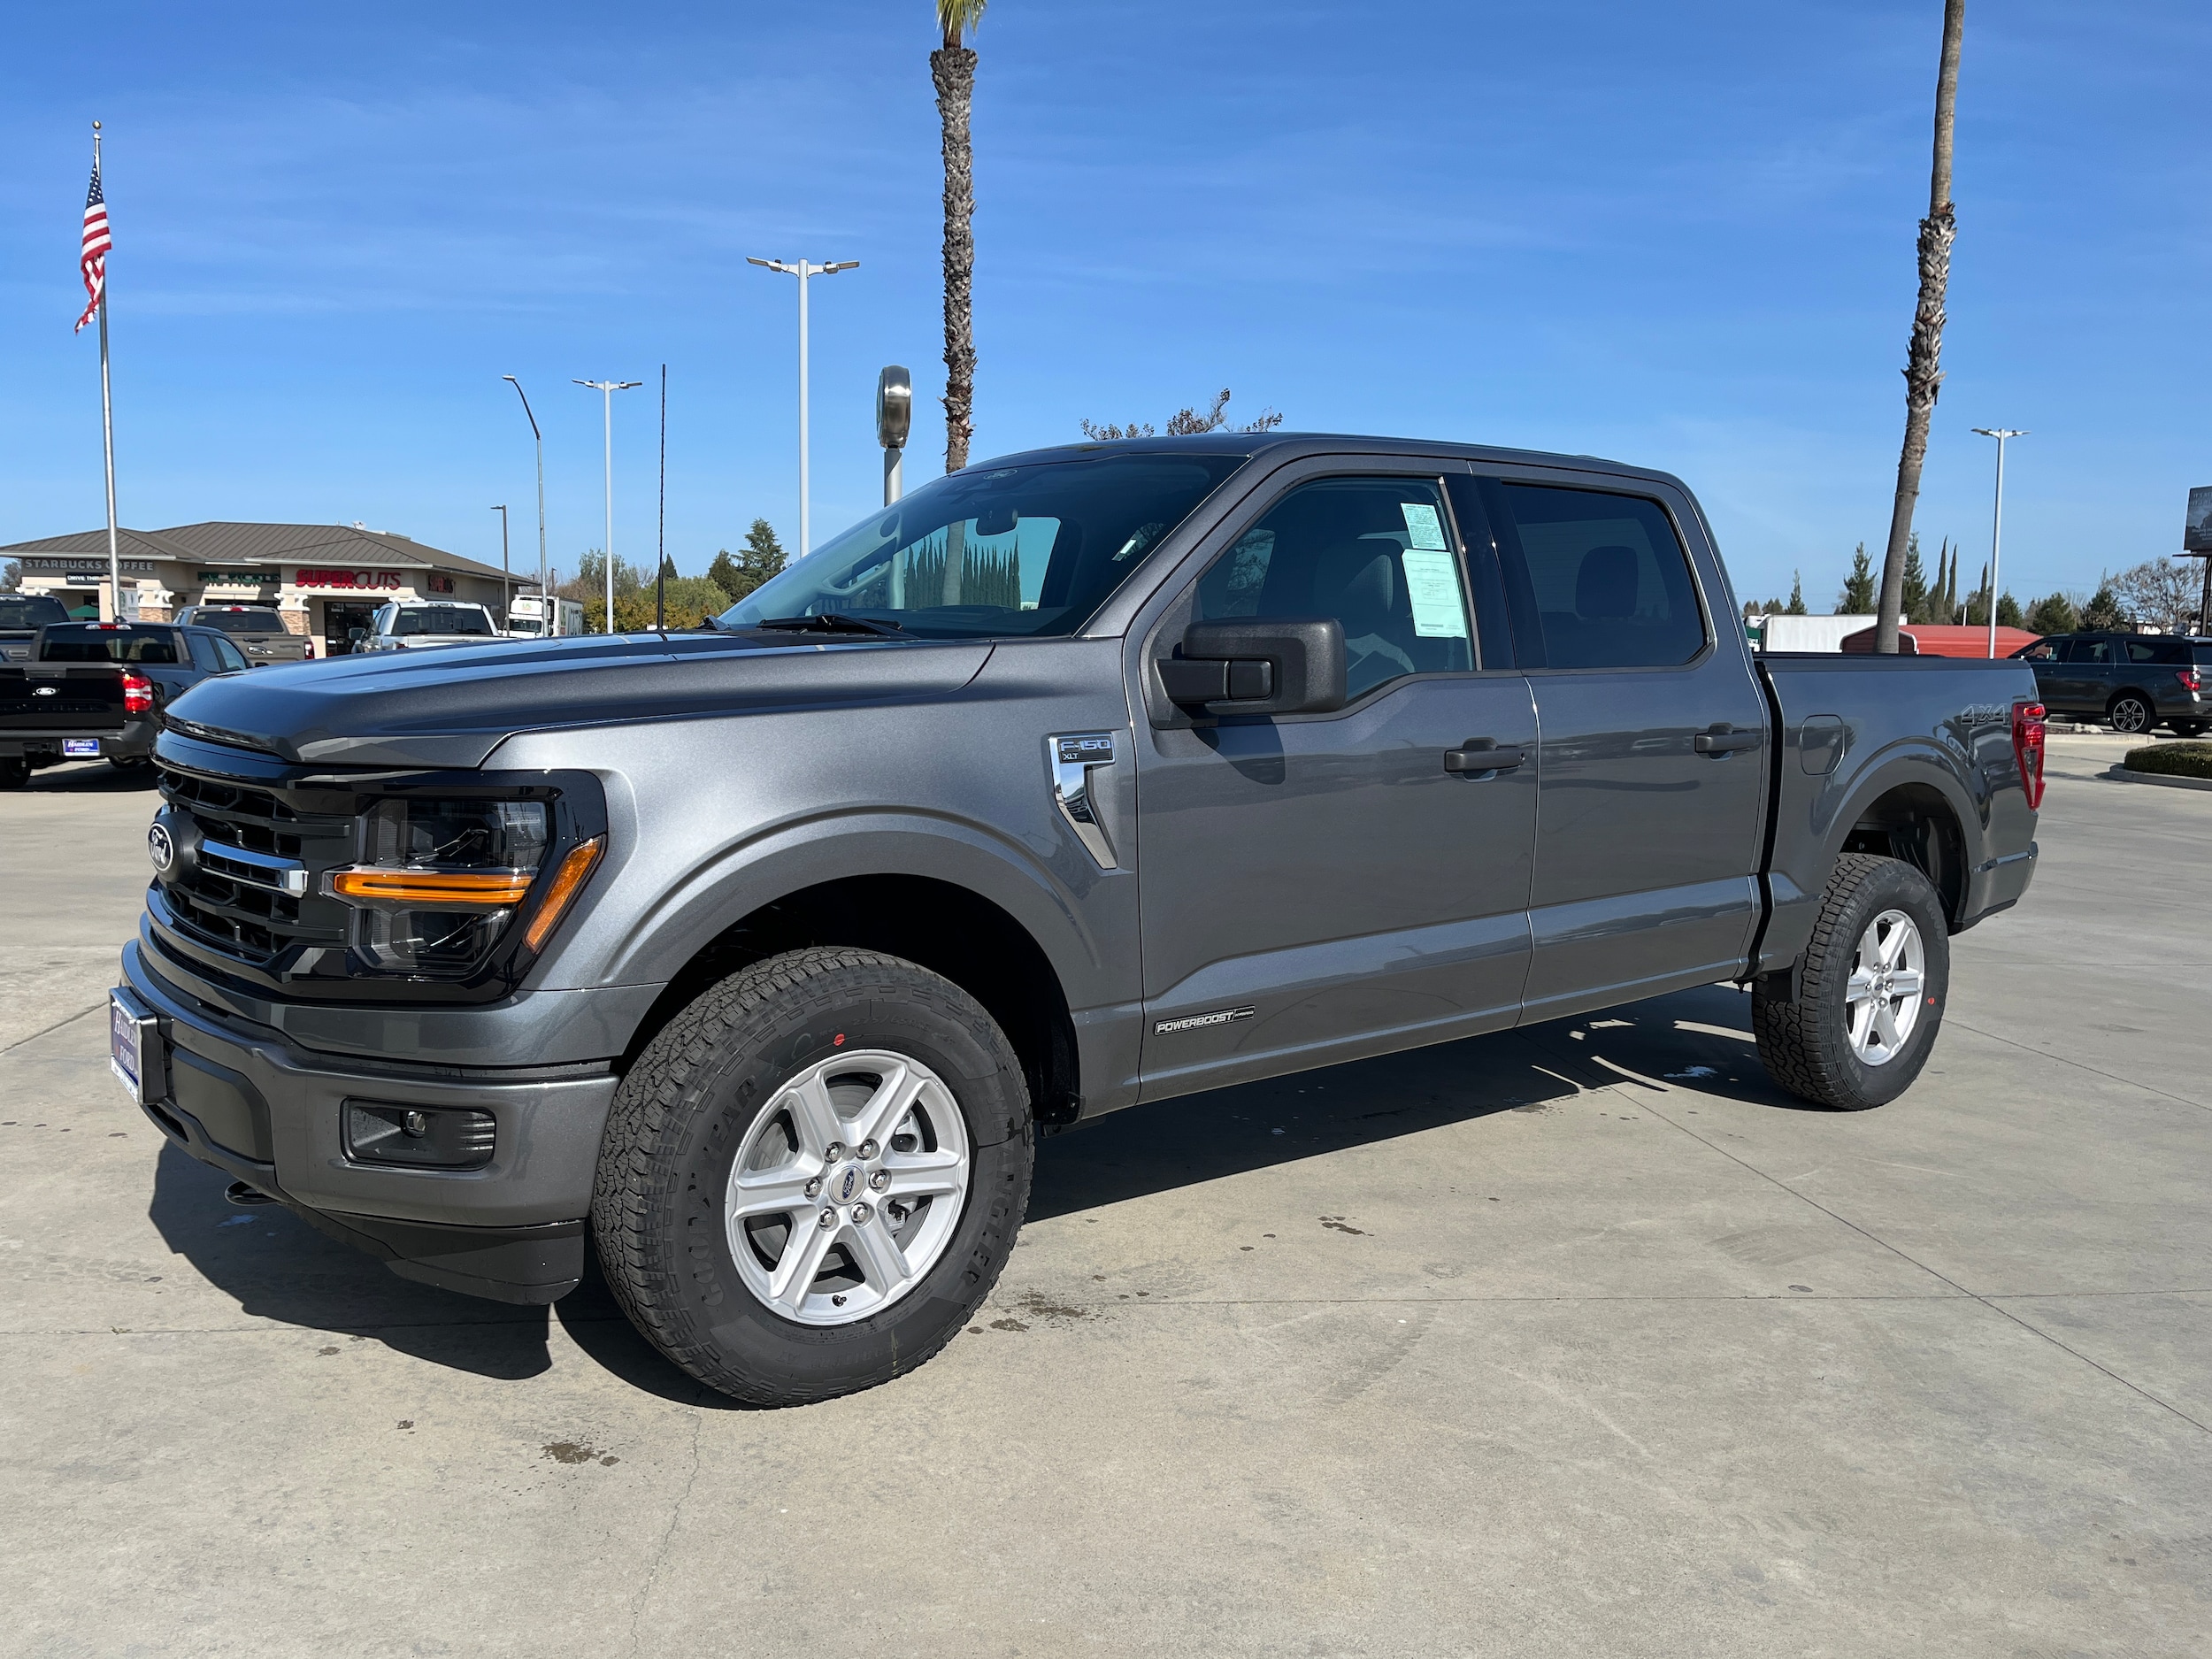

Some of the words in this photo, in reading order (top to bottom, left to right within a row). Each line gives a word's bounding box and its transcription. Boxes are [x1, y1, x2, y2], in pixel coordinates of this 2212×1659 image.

[25, 559, 102, 570] STARBUCKS
[296, 569, 401, 590] SUPERCUTS
[1060, 739, 1111, 752] F-150
[150, 828, 168, 865] Ford
[1156, 1011, 1234, 1033] POWERBOOST
[119, 1044, 135, 1071] FORD
[842, 1174, 854, 1195] Ford
